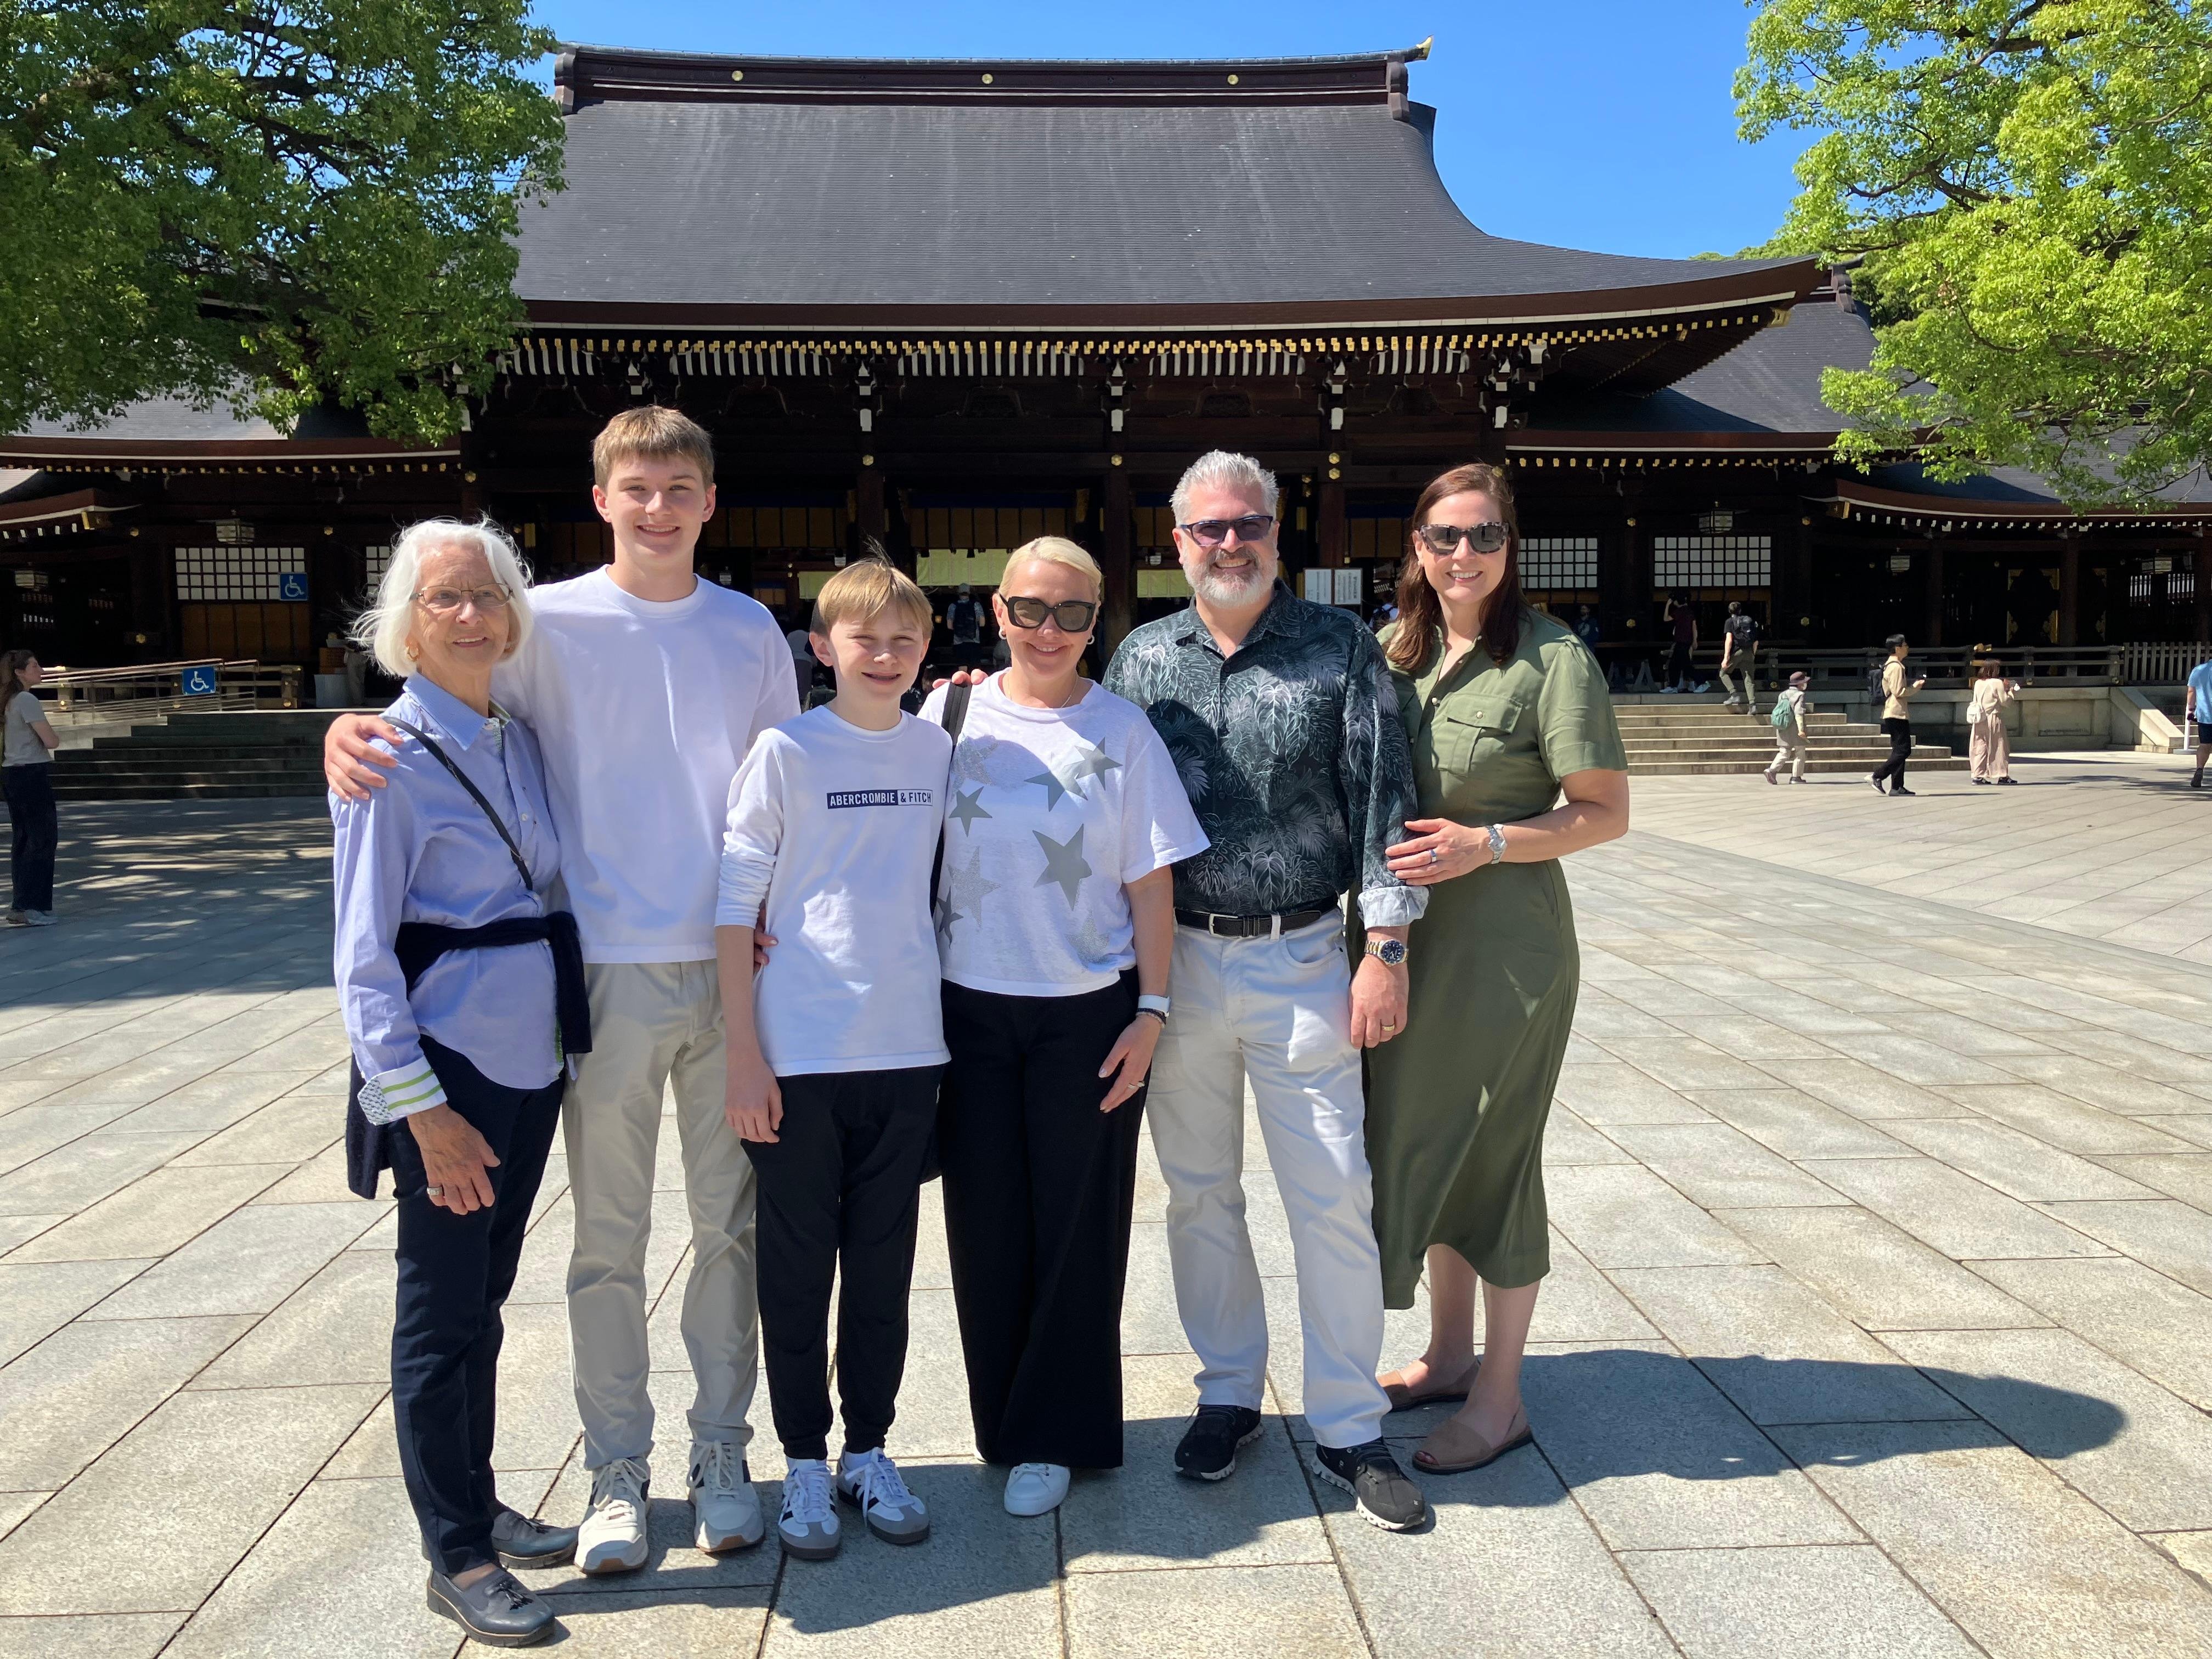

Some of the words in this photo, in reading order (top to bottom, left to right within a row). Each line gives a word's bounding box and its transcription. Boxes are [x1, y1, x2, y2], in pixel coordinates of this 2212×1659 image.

[830, 792, 896, 806] ABERCROMBIE
[900, 792, 906, 803] &
[909, 792, 932, 803] FITCH
